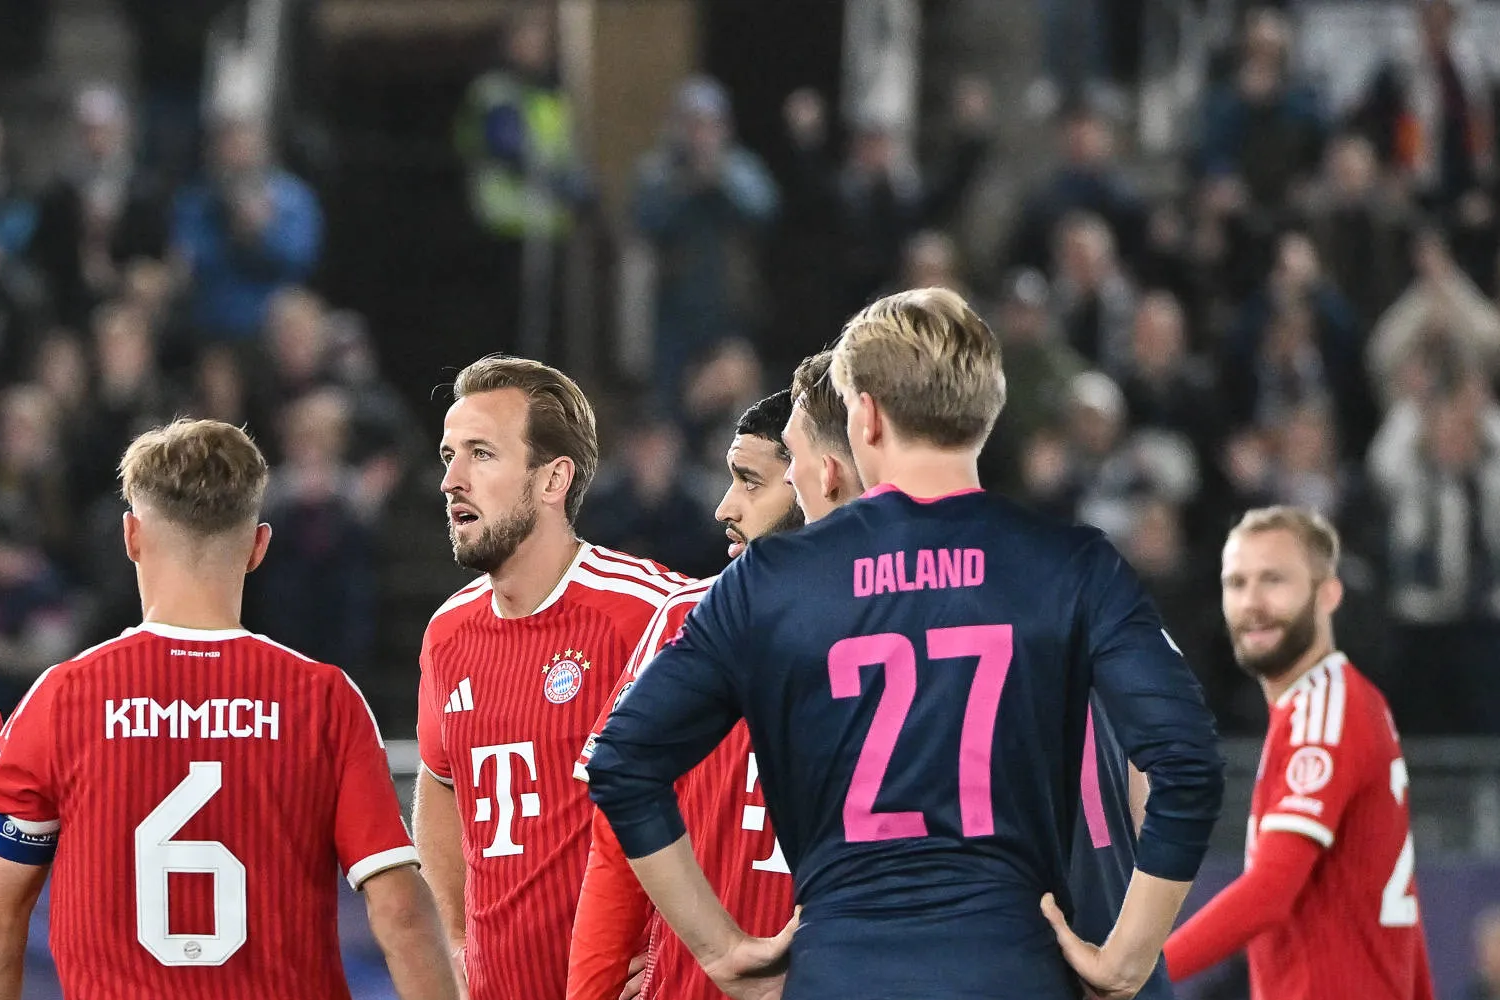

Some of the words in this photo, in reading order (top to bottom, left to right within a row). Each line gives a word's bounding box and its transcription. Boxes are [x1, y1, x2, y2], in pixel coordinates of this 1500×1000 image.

[853, 548, 985, 597] DALAND
[105, 697, 280, 740] KIMMICH
[827, 624, 1013, 842] 27
[471, 740, 541, 858] T
[134, 761, 247, 967] 6
